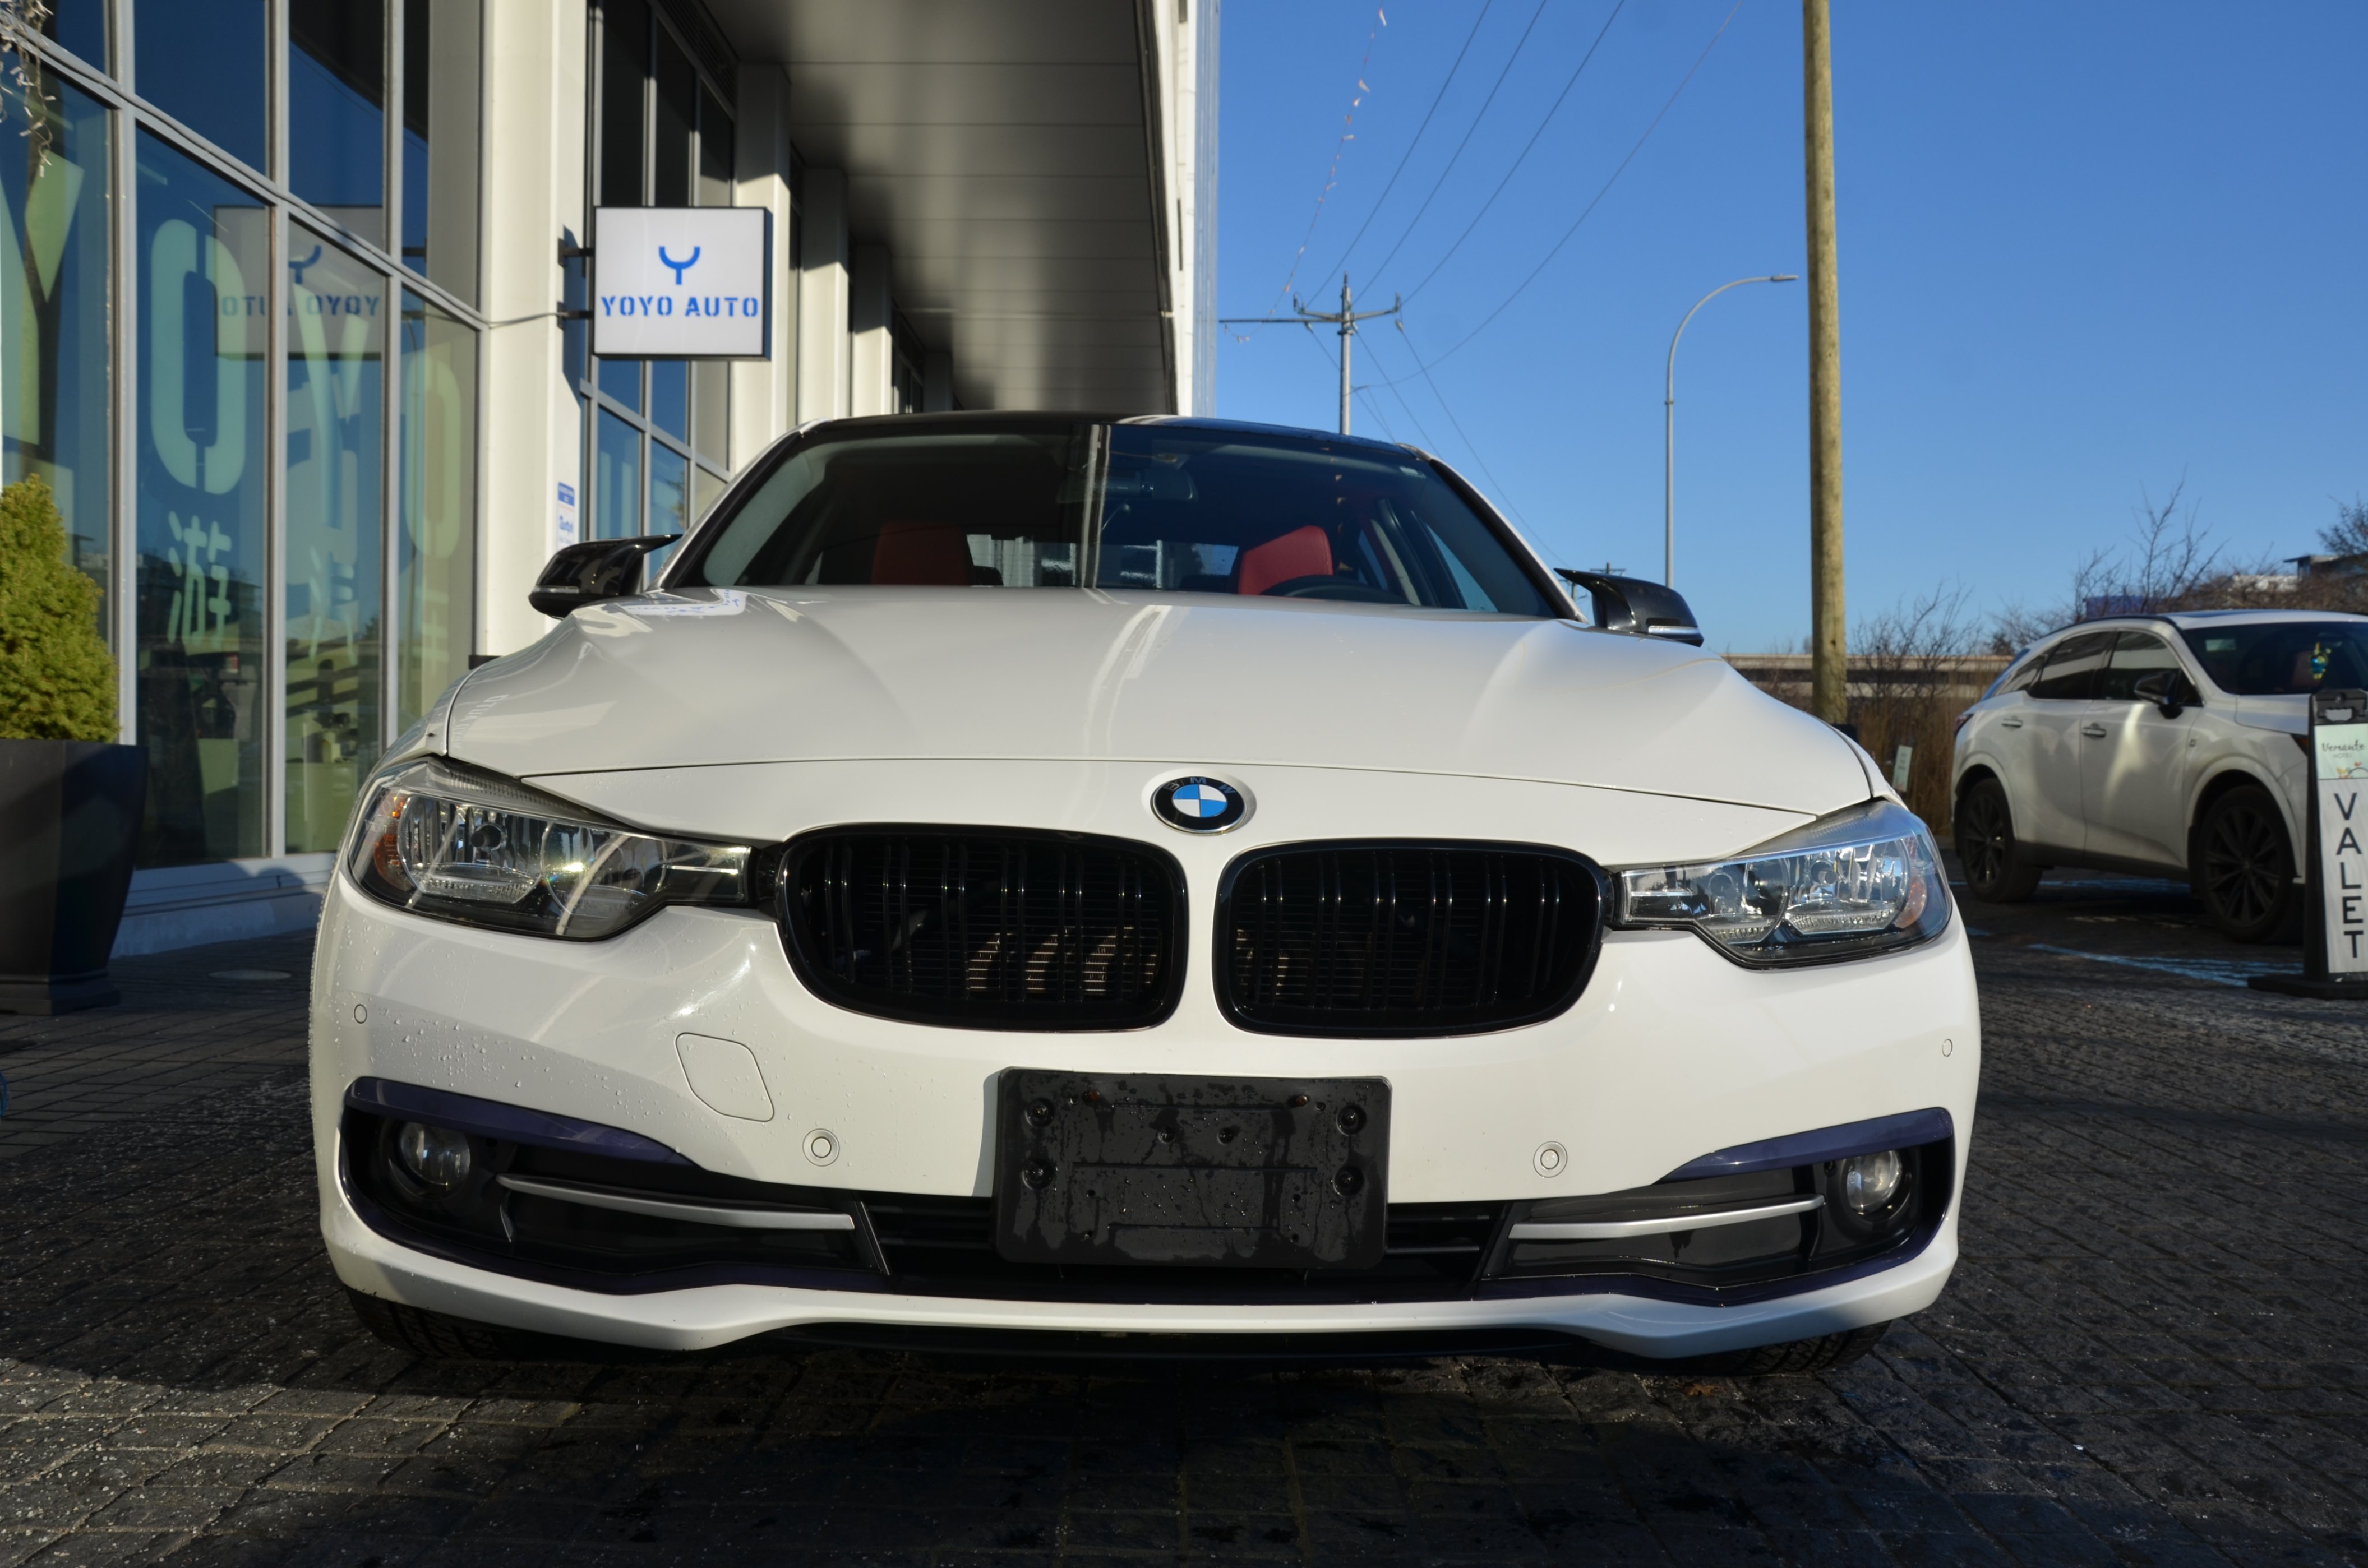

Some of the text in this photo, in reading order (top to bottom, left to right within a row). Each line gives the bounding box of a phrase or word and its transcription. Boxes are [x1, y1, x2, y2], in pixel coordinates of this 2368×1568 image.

[601, 295, 758, 317] YOYO AUTO
[1164, 776, 1236, 794] BMW
[2334, 792, 2364, 959] VALET
